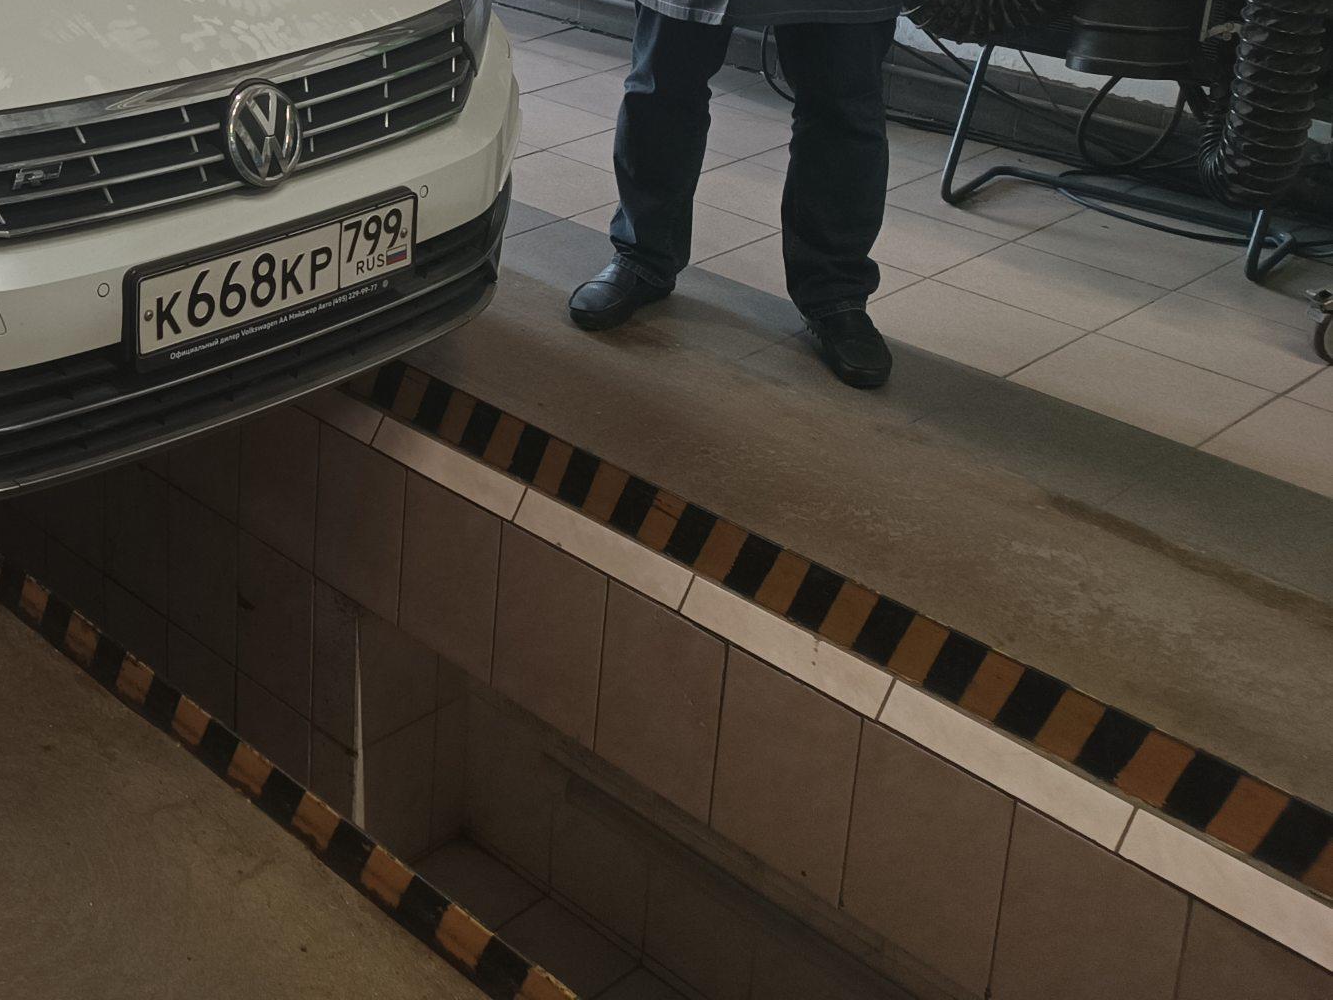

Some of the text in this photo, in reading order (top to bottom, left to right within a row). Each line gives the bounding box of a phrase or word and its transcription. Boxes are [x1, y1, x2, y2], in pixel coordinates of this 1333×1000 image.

[157, 208, 403, 341] К668КР 799
[356, 253, 385, 276] RUS
[170, 338, 219, 359] Официальный
[220, 332, 240, 344] дилер
[241, 320, 278, 336] Volkswagen
